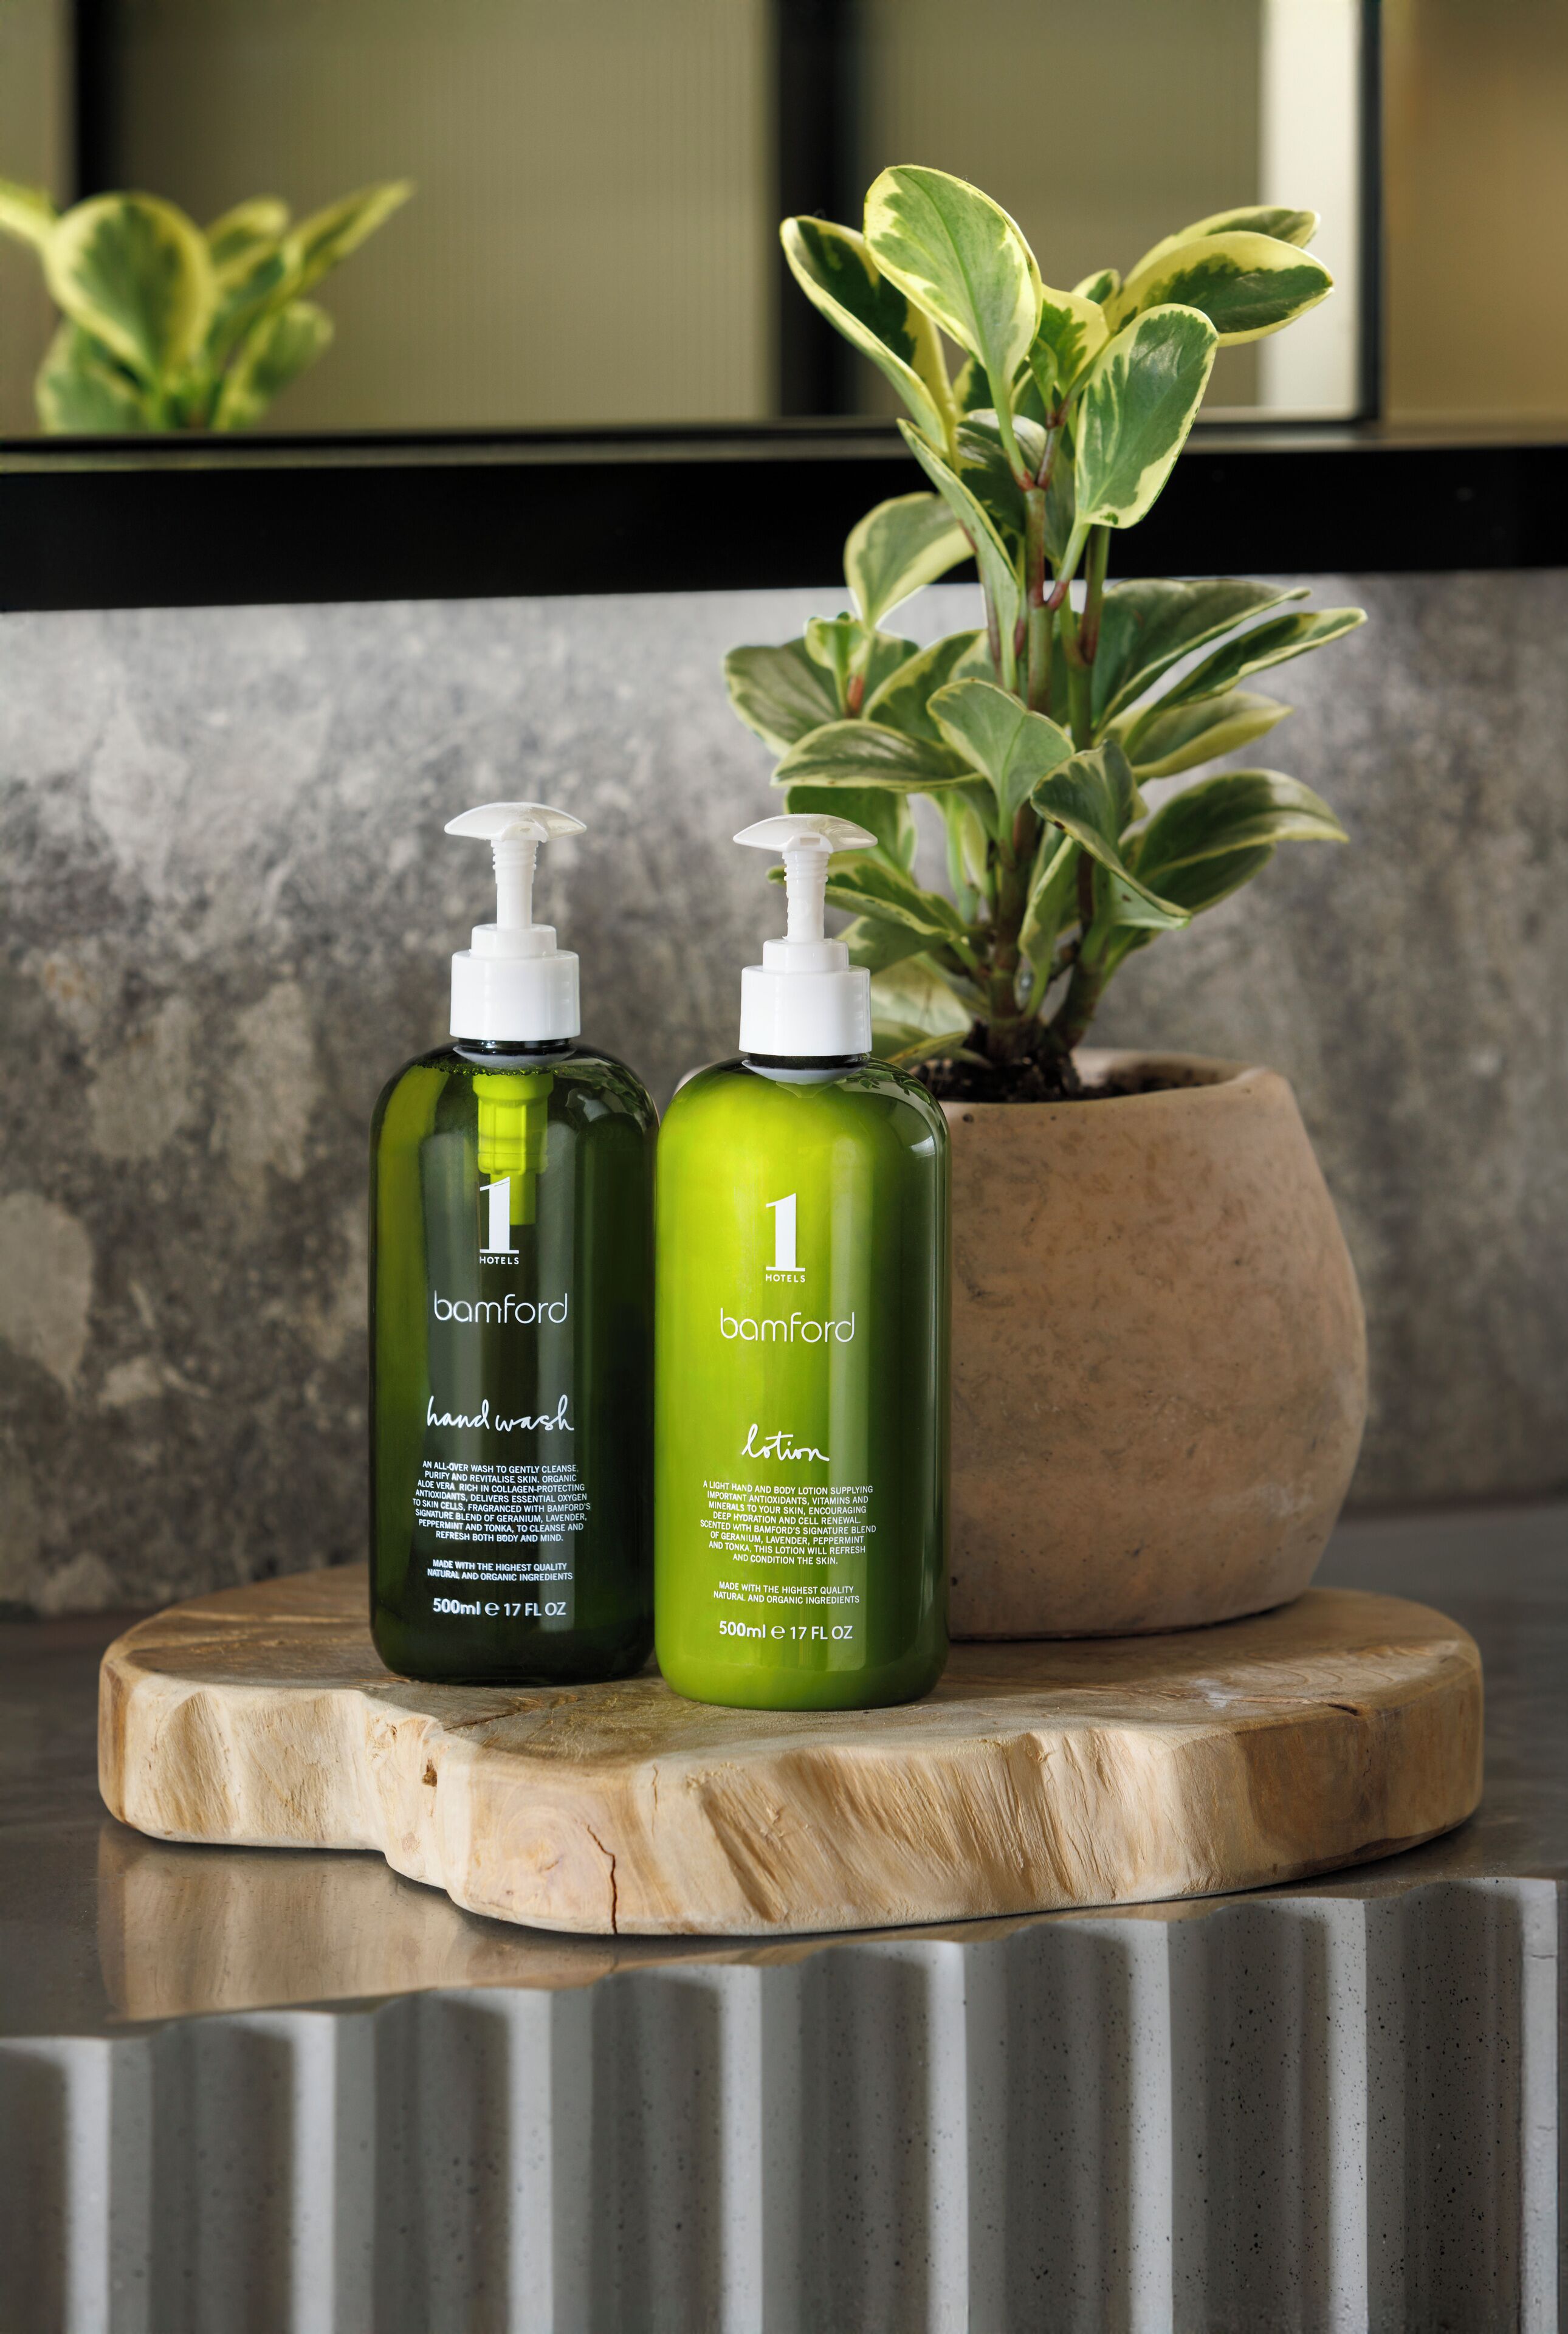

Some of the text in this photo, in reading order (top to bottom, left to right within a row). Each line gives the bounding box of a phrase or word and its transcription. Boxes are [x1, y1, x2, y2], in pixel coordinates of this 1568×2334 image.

[480, 1176, 520, 1254] 1
[766, 1193, 806, 1272] 1
[479, 1256, 520, 1265] HOTELS
[765, 1273, 806, 1283] HOTELS
[434, 1290, 568, 1324] bamford
[720, 1307, 854, 1343] bamford
[427, 1394, 574, 1431] hand wash
[741, 1423, 830, 1462] lotion
[434, 1462, 468, 1472] ALL-OVER
[471, 1464, 493, 1473] WASH
[496, 1465, 507, 1473] TO
[509, 1465, 540, 1474] GENTLY
[425, 1470, 577, 1483] PURIFY AND REVITALISE SKIN. ORGANIC
[417, 1479, 435, 1489] ALOE
[459, 1483, 478, 1492] RICH
[491, 1483, 585, 1493] COLLAGEN-PROTECTING
[709, 1481, 730, 1490] LIGHT
[732, 1483, 753, 1493] HAND
[754, 1485, 772, 1494] AND
[774, 1486, 796, 1495] BODY
[798, 1487, 828, 1495] LOTION
[830, 1485, 873, 1495] SUPPLYING
[415, 1489, 587, 1503] ANTIOXIDANTS, DELIVERS ESSENTIAL OXYGEN
[707, 1490, 868, 1506] IMPORTANT ANTIOXIDANTS, VITAMINS AND
[412, 1498, 421, 1507] TO
[422, 1499, 439, 1509] SKIN
[441, 1501, 466, 1512] CELLS,
[468, 1504, 521, 1513] FRAGRANCED
[523, 1504, 545, 1513] WITH
[709, 1501, 867, 1516] MINERALS TO YOUR SKIN, ENCOURAGING
[415, 1509, 454, 1520] SIGNATURE
[456, 1512, 482, 1522] BLEND
[497, 1514, 543, 1523] GERANIUM,
[546, 1513, 587, 1522] LAVENDER,
[713, 1511, 732, 1520] DEEP
[733, 1513, 777, 1524] HYDRATION
[821, 1516, 861, 1524] RENEWAL.
[418, 1518, 464, 1530] PEPPERMINT
[465, 1523, 483, 1532] AND
[484, 1524, 514, 1533] TONKA,
[529, 1523, 566, 1532] CLEANSE
[568, 1523, 583, 1531] AND
[700, 1520, 731, 1530] SCENTED
[732, 1523, 752, 1532] WITH
[803, 1526, 848, 1535] SIGNATURE
[851, 1525, 876, 1534] BLEND
[436, 1530, 470, 1541] REFRESH
[472, 1533, 494, 1541] BOTH
[497, 1534, 518, 1542] BODY
[540, 1534, 563, 1542] MIND.
[721, 1532, 763, 1544] GERANIUM,
[766, 1536, 810, 1546] LAVENDER,
[813, 1536, 864, 1545] PEPPERMINT
[709, 1541, 724, 1550] AND
[725, 1542, 752, 1553] TONKA,
[754, 1544, 773, 1554] THIS
[775, 1546, 805, 1555] LOTION
[829, 1546, 865, 1554] REFRESH
[433, 1559, 453, 1569] MADE
[455, 1561, 476, 1570] WITH
[534, 1563, 567, 1572] QUALITY
[732, 1553, 749, 1562] AND
[750, 1554, 795, 1565] CONDITION
[427, 1568, 573, 1581] NATURAL AND ORGANIC INGREDIENTS
[719, 1581, 854, 1596] MADE WITH THE HIGHEST QUALITY
[714, 1591, 859, 1604] NATURAL AND ORGANIC INGREDIENTS
[433, 1598, 481, 1616] 500ml
[504, 1602, 521, 1616] 17
[525, 1602, 542, 1616] FL
[545, 1602, 566, 1616] OZ
[719, 1620, 766, 1639] 500ml
[790, 1627, 807, 1639] 17
[811, 1626, 828, 1640] FL
[831, 1625, 853, 1639] OZ
